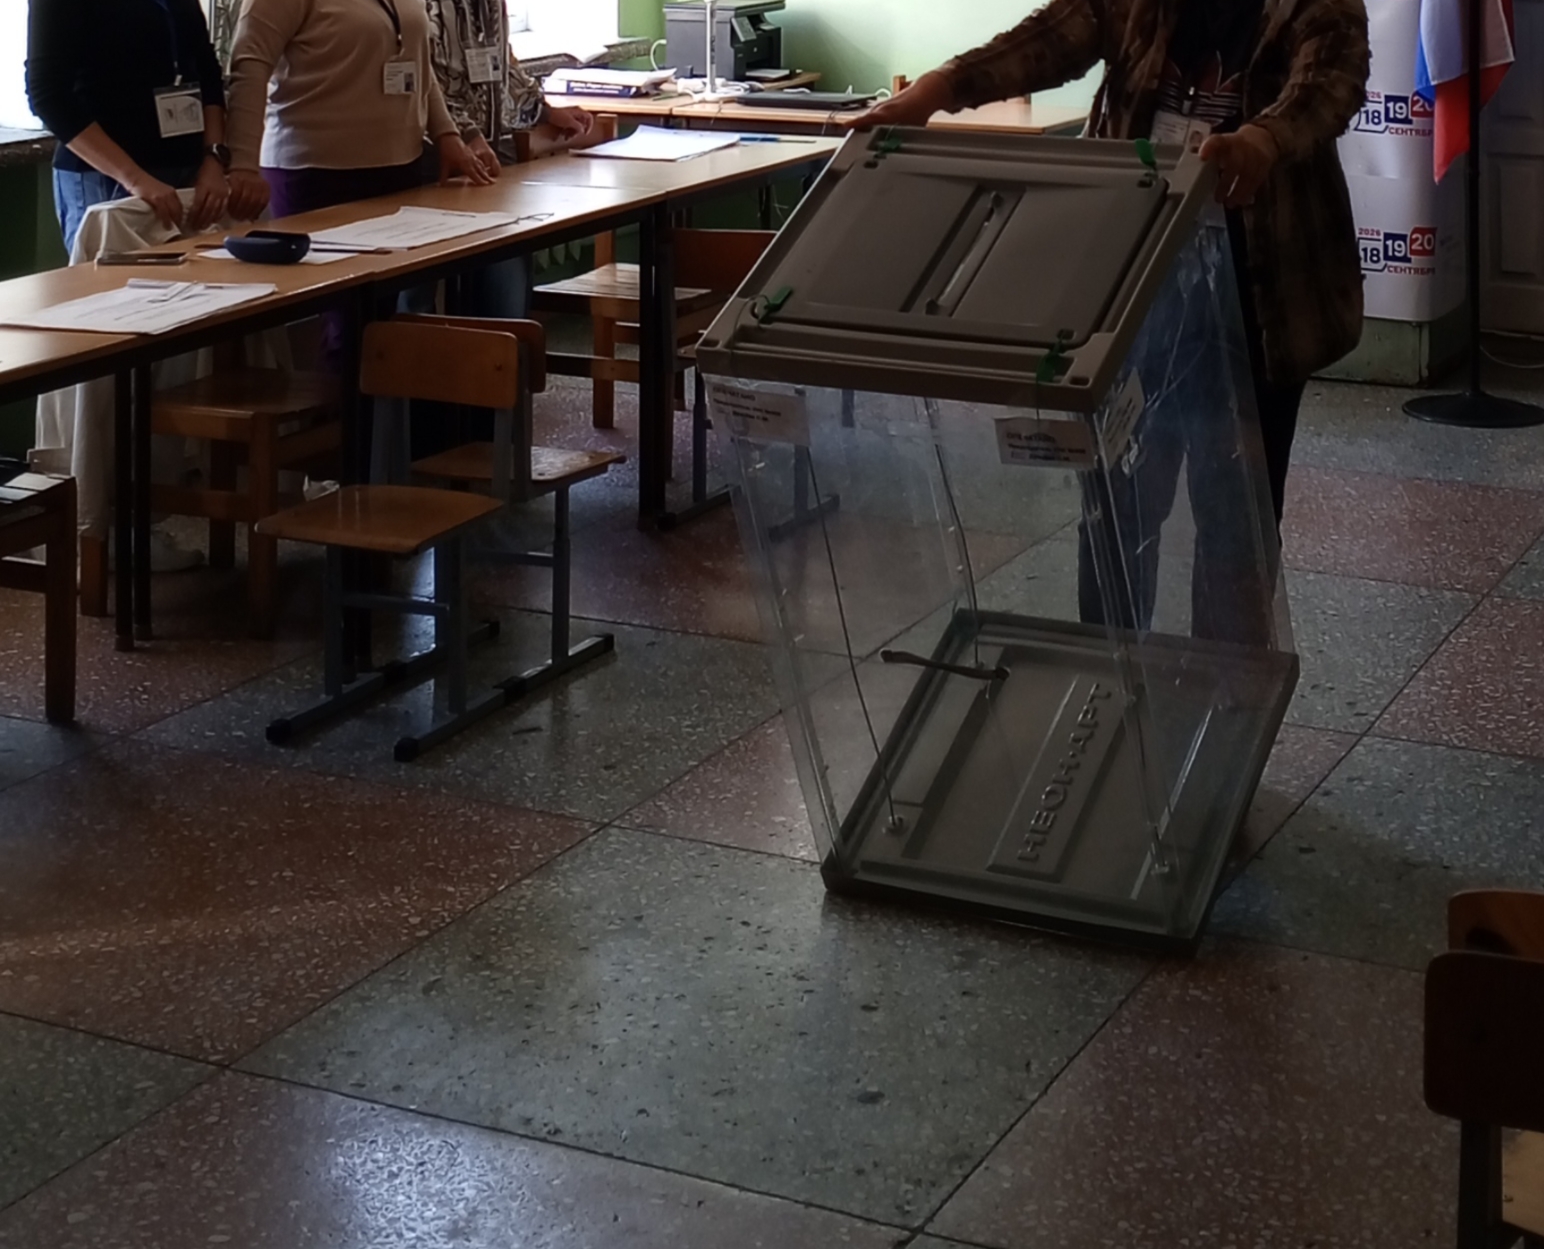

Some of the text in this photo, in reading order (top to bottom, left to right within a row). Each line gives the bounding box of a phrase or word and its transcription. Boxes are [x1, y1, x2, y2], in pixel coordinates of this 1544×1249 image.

[1363, 109, 1382, 125] 18
[1386, 102, 1407, 119] 19
[1388, 127, 1433, 137] СЕНТЯБР
[1358, 227, 1381, 237] 2026
[1361, 233, 1435, 264] 18 19 20
